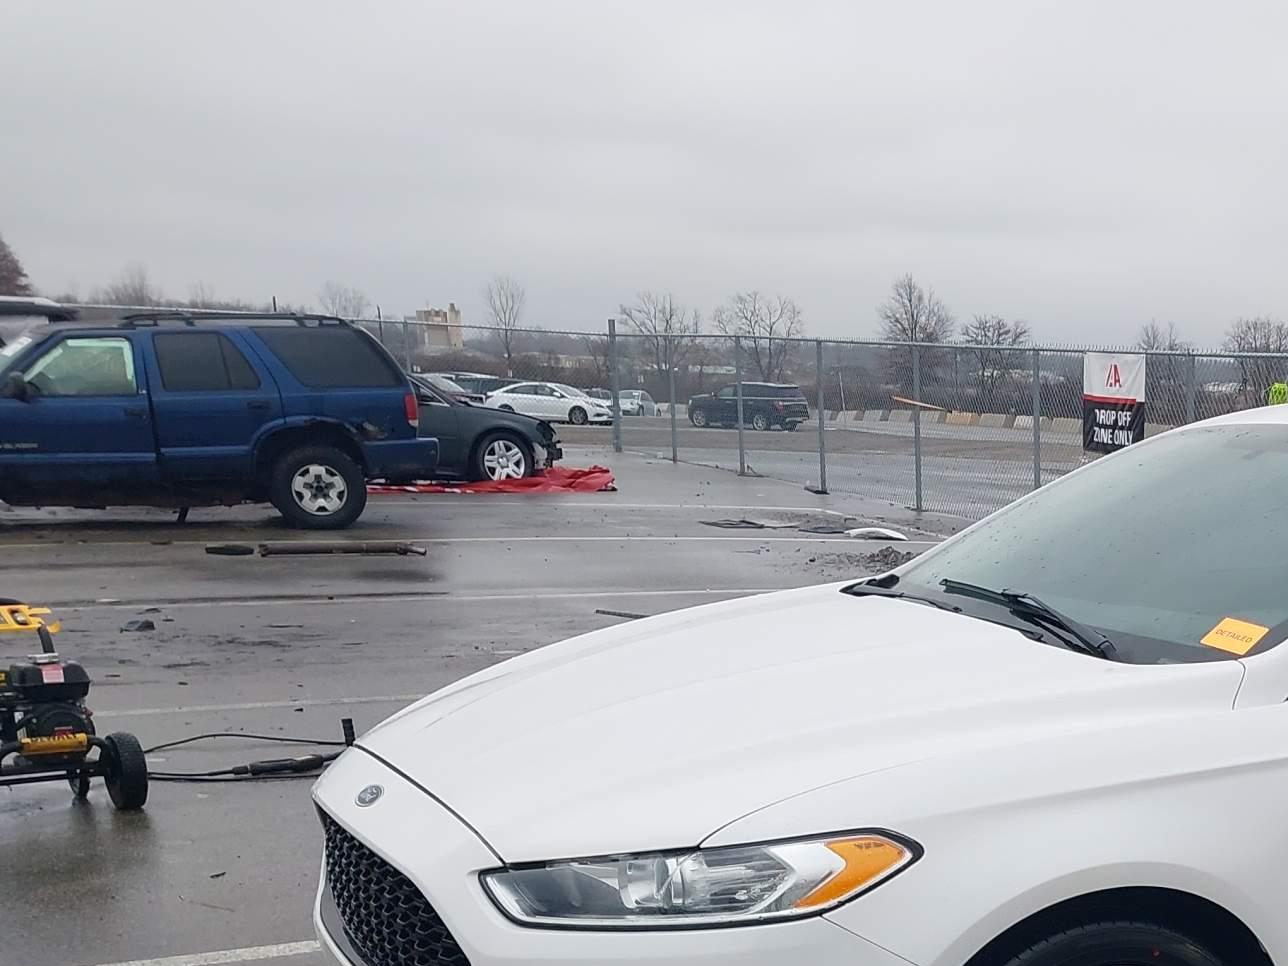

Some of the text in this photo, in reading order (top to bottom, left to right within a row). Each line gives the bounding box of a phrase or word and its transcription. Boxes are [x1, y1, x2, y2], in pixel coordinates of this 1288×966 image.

[1117, 410, 1132, 427] OFF
[1113, 430, 1134, 446] ONLY
[1215, 629, 1253, 644] DETAILED
